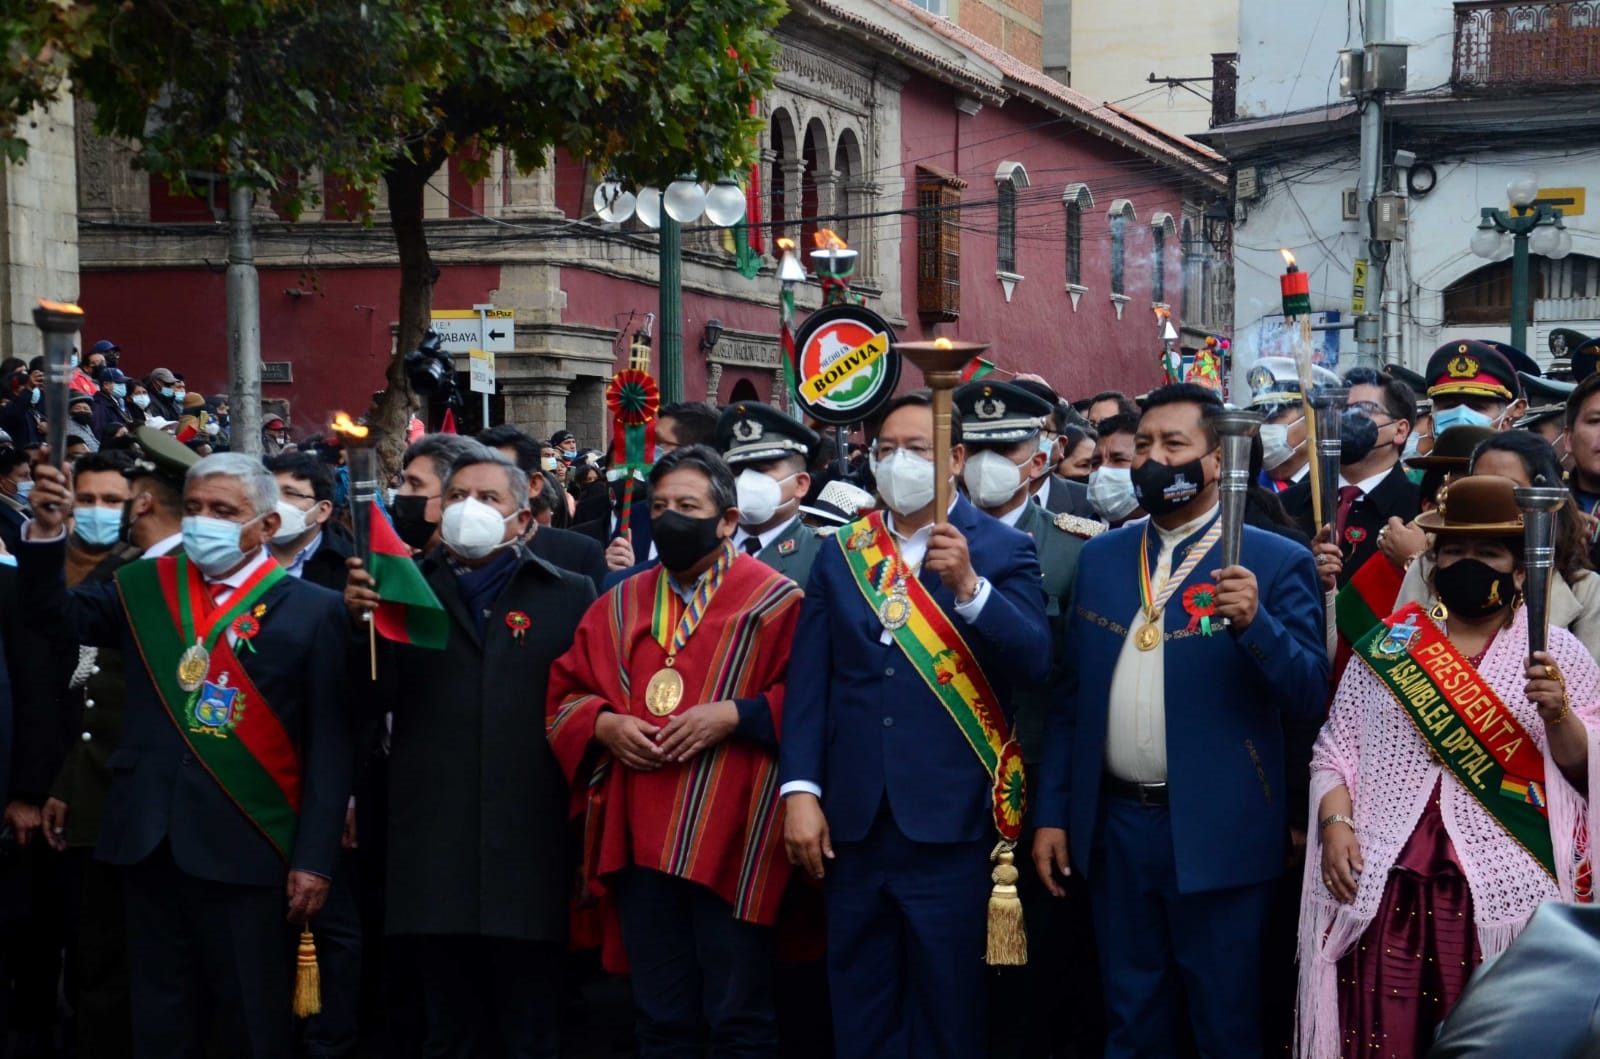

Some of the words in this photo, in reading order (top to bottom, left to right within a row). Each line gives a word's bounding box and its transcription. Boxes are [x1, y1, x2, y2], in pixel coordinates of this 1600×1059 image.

[813, 343, 879, 393] BOLIVIA
[821, 351, 841, 368] HECHO
[841, 345, 850, 355] EN
[1387, 658, 1455, 737] ASAMBLEA
[1440, 725, 1496, 791] DPTAL.
[1417, 641, 1524, 763] PRESIDENTA
